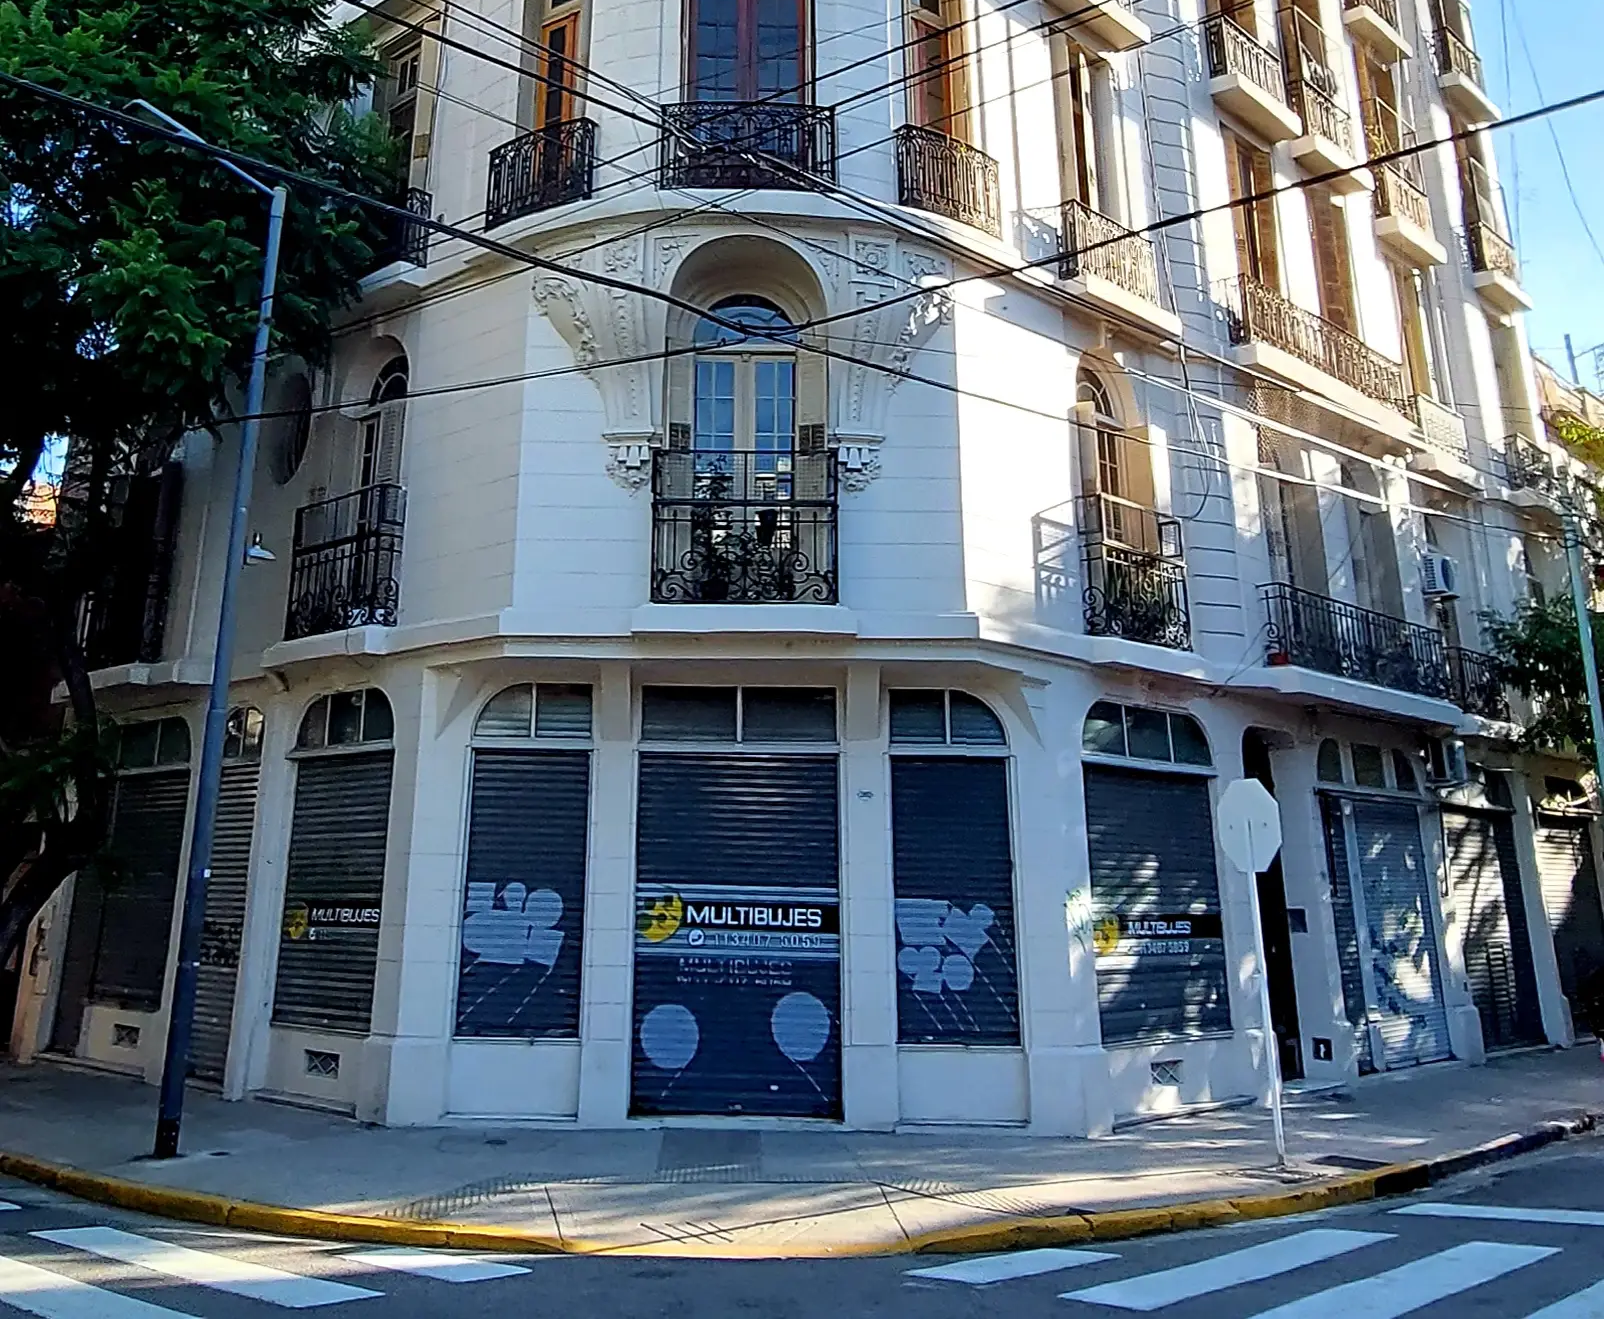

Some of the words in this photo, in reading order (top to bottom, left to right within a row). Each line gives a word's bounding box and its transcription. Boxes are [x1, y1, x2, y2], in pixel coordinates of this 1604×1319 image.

[311, 908, 380, 922] MULTIBUJES
[686, 905, 822, 927] MULTIBUJES
[1127, 921, 1191, 935] MULTIBUJES
